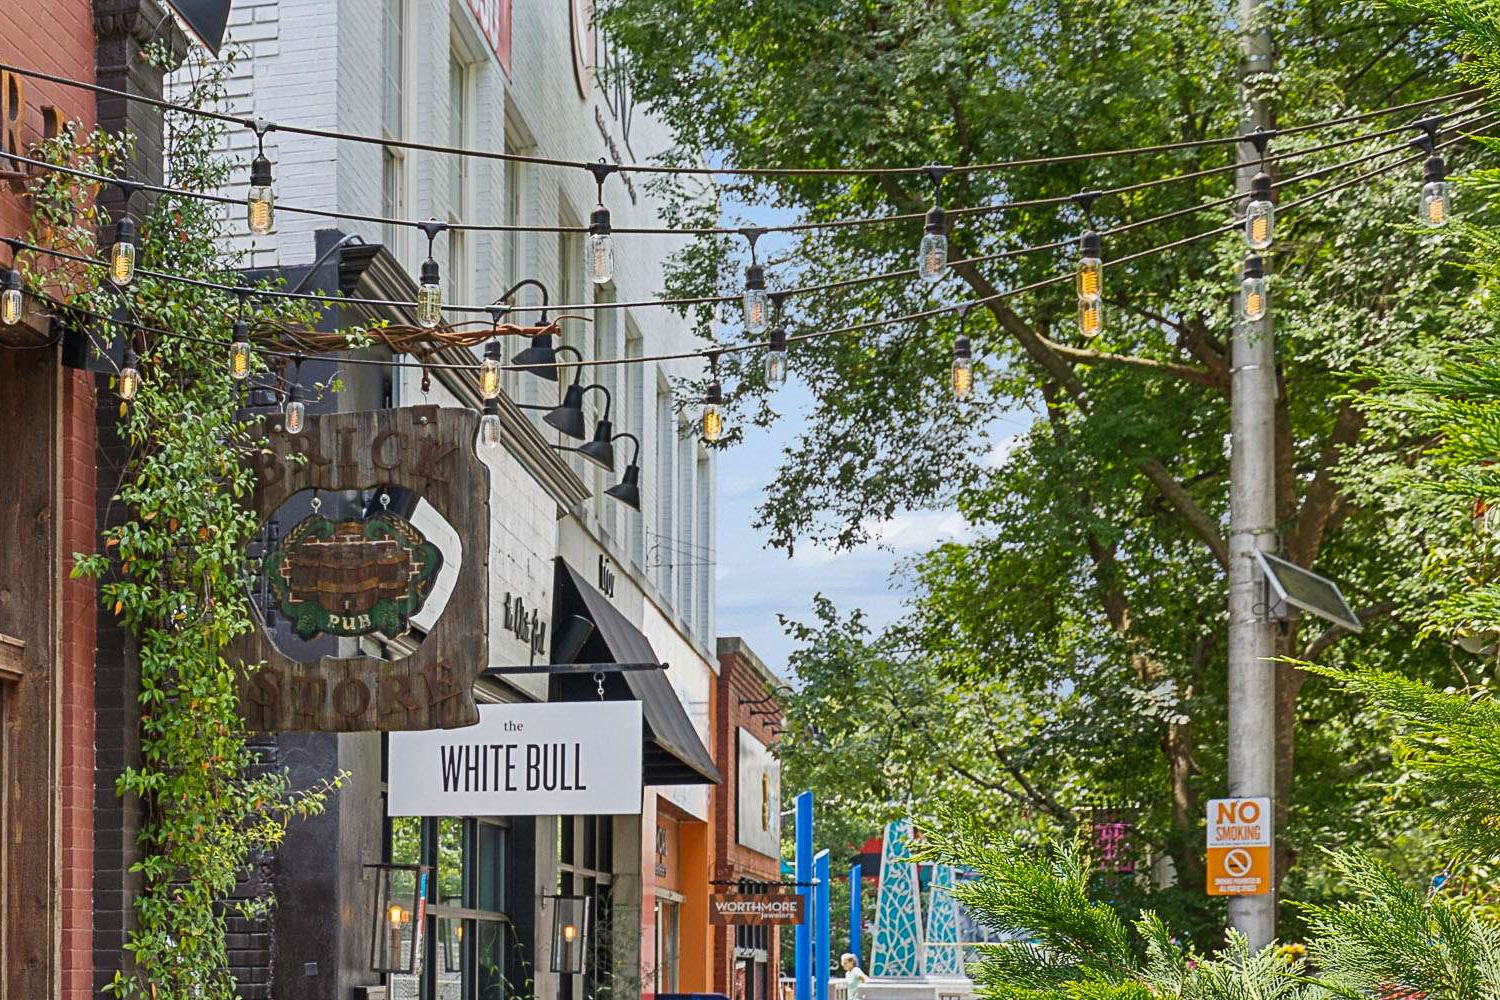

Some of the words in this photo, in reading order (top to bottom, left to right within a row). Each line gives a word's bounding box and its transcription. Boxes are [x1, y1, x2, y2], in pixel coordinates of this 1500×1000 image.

[257, 425, 460, 486] BRICK
[327, 614, 372, 631] PUB
[245, 658, 464, 718] STORE
[504, 721, 524, 732] the
[441, 743, 518, 793] WHITE
[526, 743, 587, 792] BULL
[1217, 801, 1261, 824] NO
[1216, 825, 1261, 842] SMOKING
[715, 901, 798, 913] WORTHMORE
[760, 911, 795, 920] jewelers
